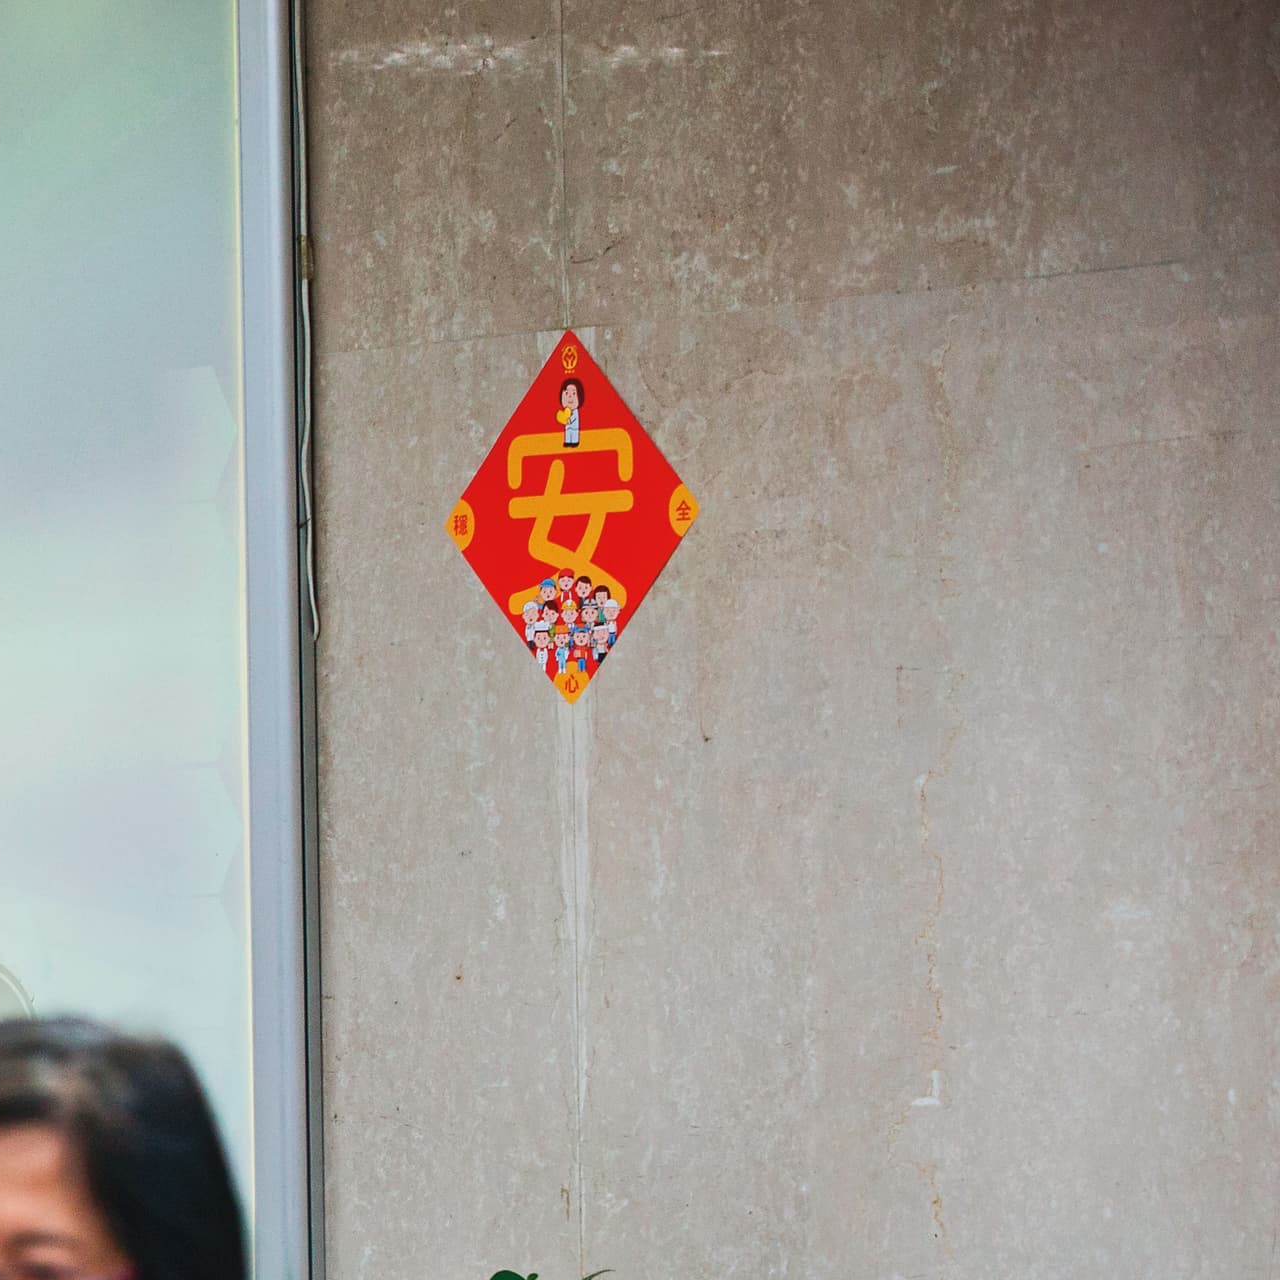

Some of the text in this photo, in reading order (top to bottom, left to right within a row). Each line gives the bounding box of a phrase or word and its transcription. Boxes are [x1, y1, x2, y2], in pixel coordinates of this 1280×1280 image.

[507, 427, 634, 616] 安
[675, 500, 692, 522] 全
[452, 514, 468, 536] 穩
[564, 674, 580, 694] 心
